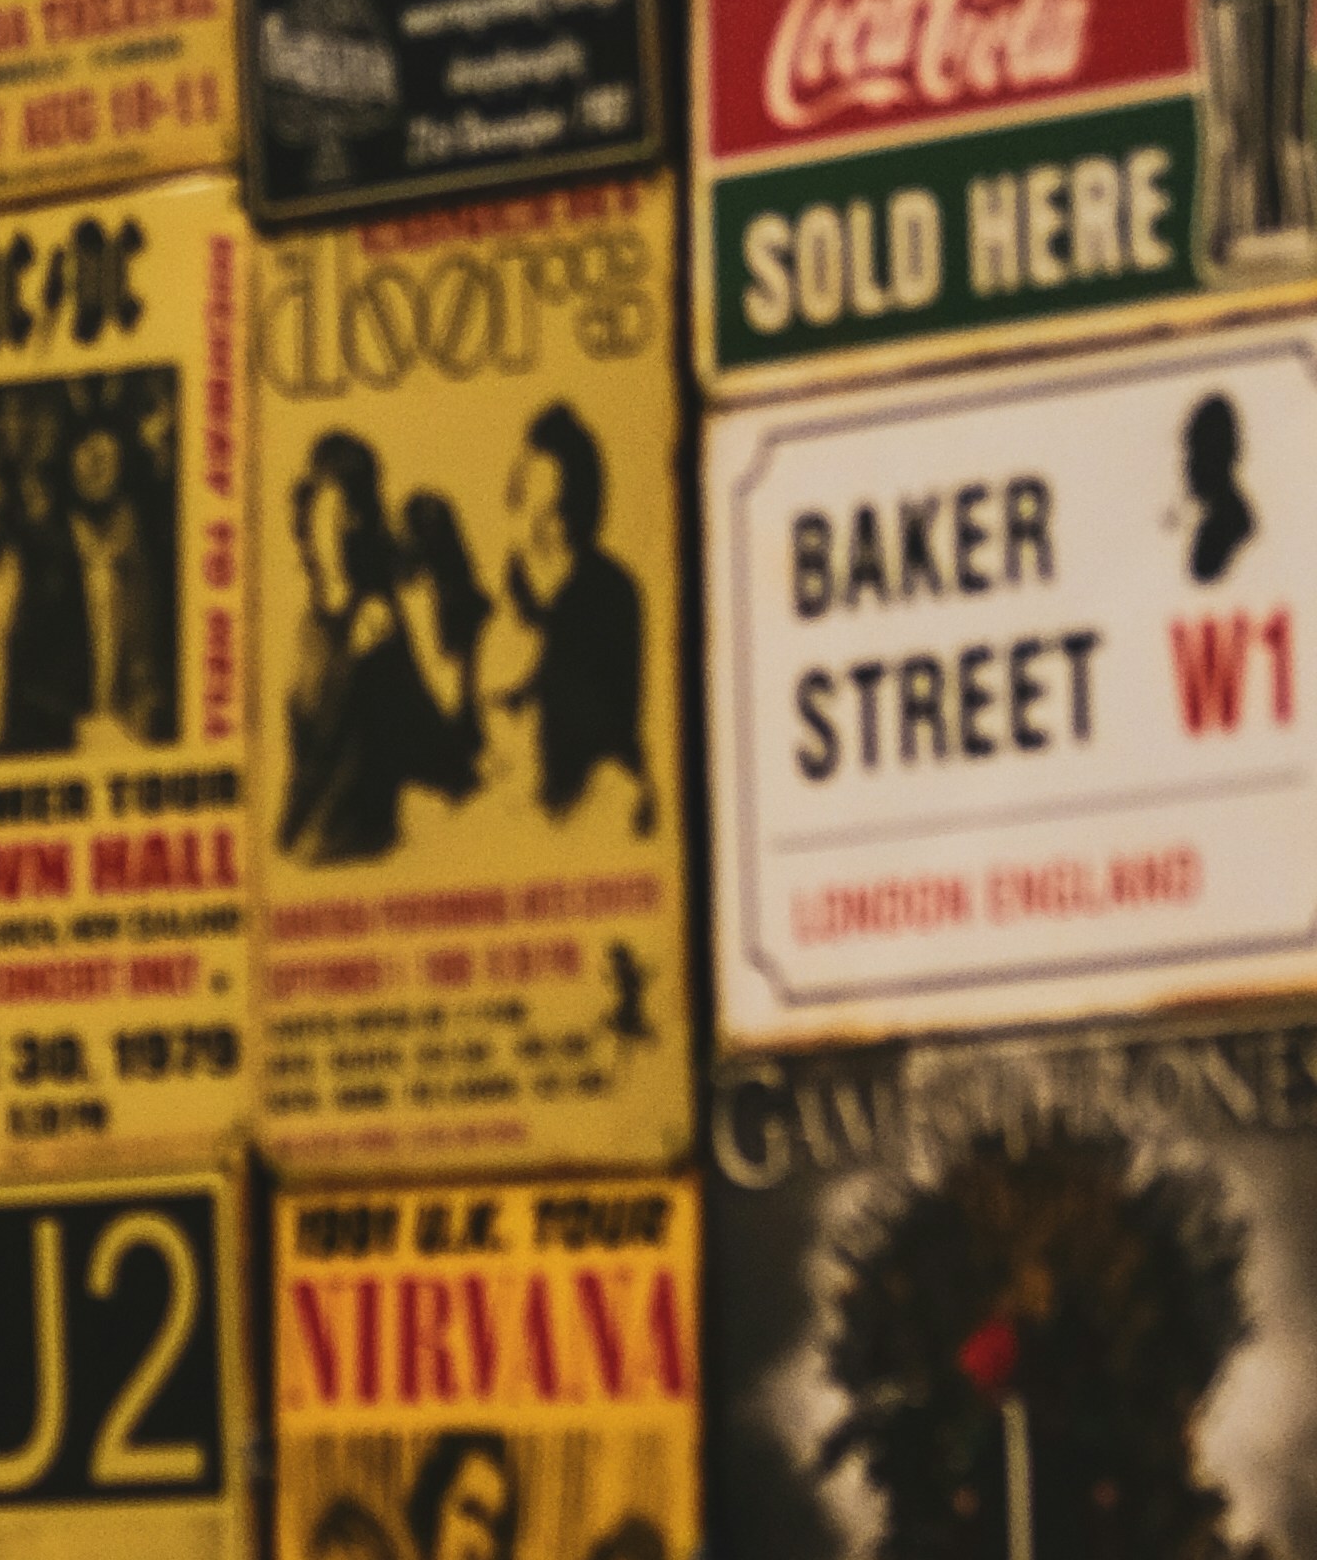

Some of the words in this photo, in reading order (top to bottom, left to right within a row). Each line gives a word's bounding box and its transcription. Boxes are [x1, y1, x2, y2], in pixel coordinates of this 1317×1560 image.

[742, 187, 941, 334] SOLD
[969, 145, 1173, 298] HERE
[792, 475, 1054, 618] BAKER
[794, 629, 1104, 782] STREET
[1169, 606, 1295, 737] W1
[92, 827, 236, 894] HALL
[788, 872, 969, 945] LONDON
[984, 841, 1203, 925] ENGLAND
[290, 1270, 689, 1406] NIRVANA
